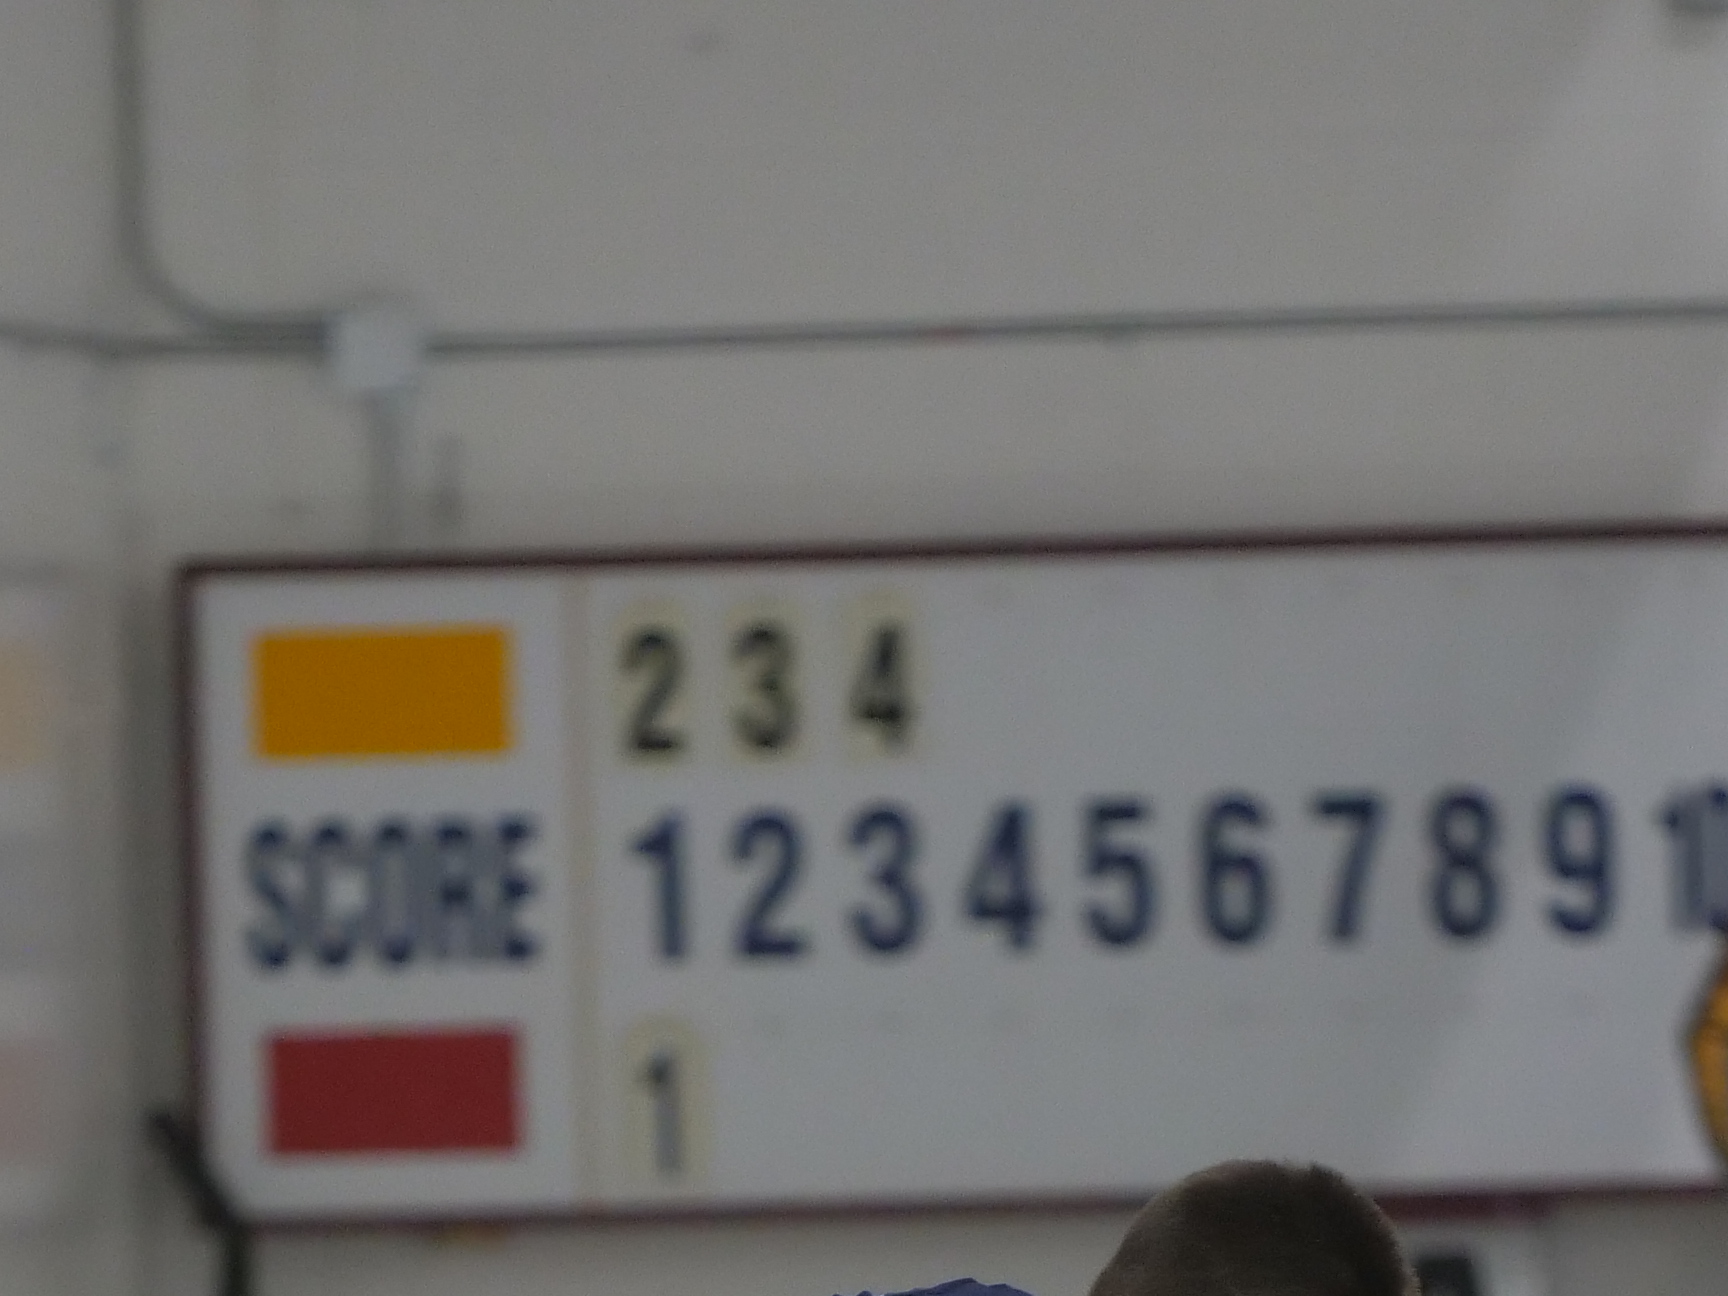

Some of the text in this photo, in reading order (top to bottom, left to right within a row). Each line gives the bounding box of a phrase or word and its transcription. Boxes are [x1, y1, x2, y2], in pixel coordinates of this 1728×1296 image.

[619, 617, 915, 761] 2 3 4
[244, 812, 541, 974] SCORE
[626, 808, 691, 964] 1
[727, 805, 811, 965] 2
[844, 799, 927, 961] 3
[960, 796, 1046, 956] 4
[1081, 795, 1159, 953] 5
[1195, 790, 1276, 950] 6
[1308, 788, 1388, 946] 7
[1425, 786, 1501, 944] 8
[1539, 783, 1617, 940] 9
[633, 1044, 688, 1178] 1
